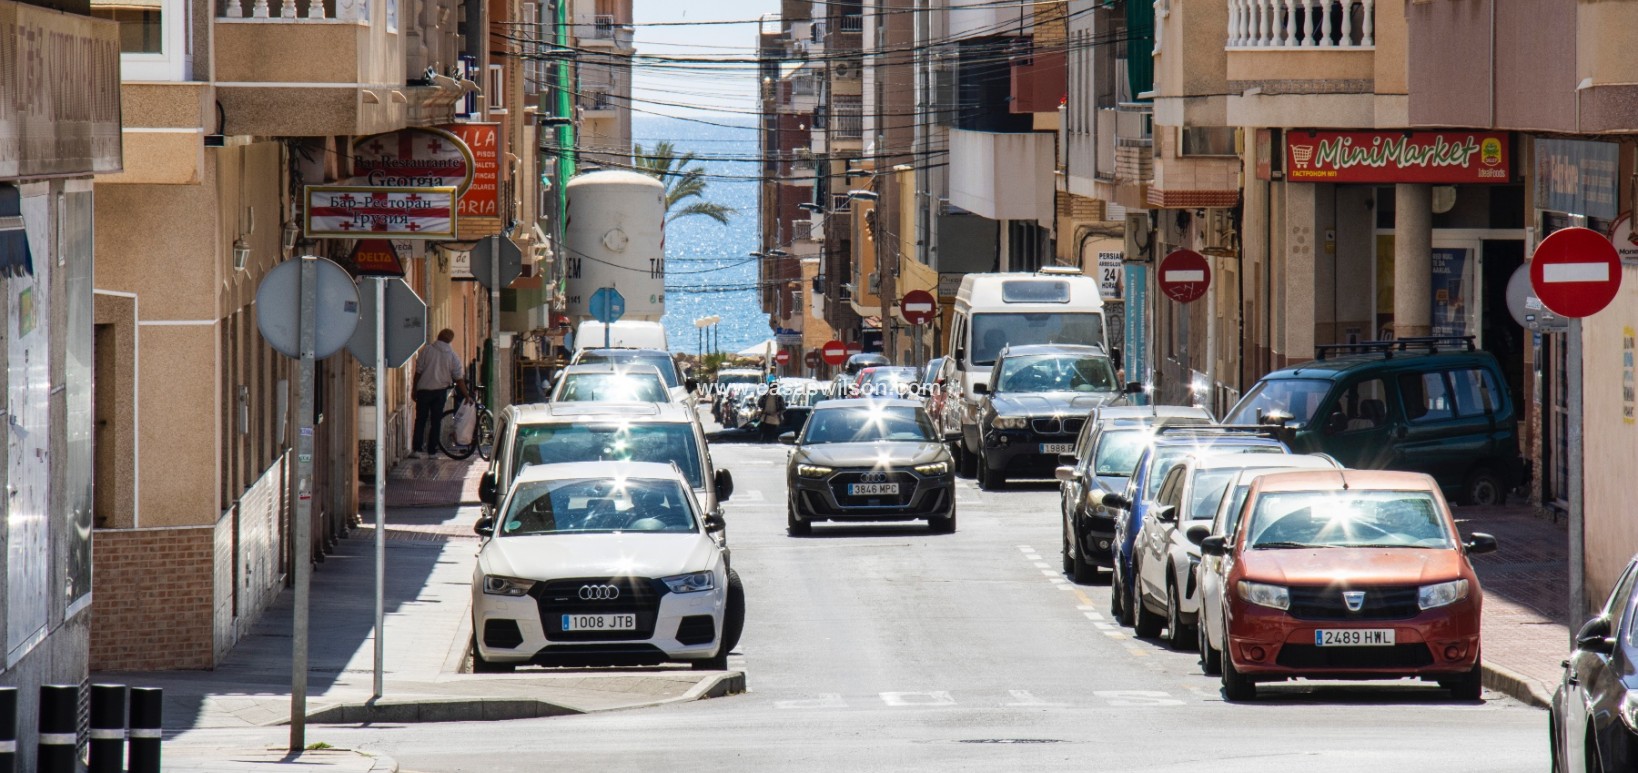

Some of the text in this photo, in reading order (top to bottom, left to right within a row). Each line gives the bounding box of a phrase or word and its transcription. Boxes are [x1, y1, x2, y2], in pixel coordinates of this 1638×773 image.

[1315, 134, 1481, 170] MiniMarket
[355, 155, 461, 168] Bar Restaurante
[367, 170, 444, 186] Georgia
[330, 196, 432, 213] Бар-Ресторан
[458, 199, 495, 214] ARIA
[353, 211, 409, 227] Грузия
[358, 252, 392, 262] DELTA
[1104, 268, 1116, 281] 24
[1046, 444, 1065, 453] 1988
[854, 484, 897, 494] 3846 MPC
[574, 615, 633, 628] 1008 JTB
[1325, 631, 1391, 644] 2489 HWL
